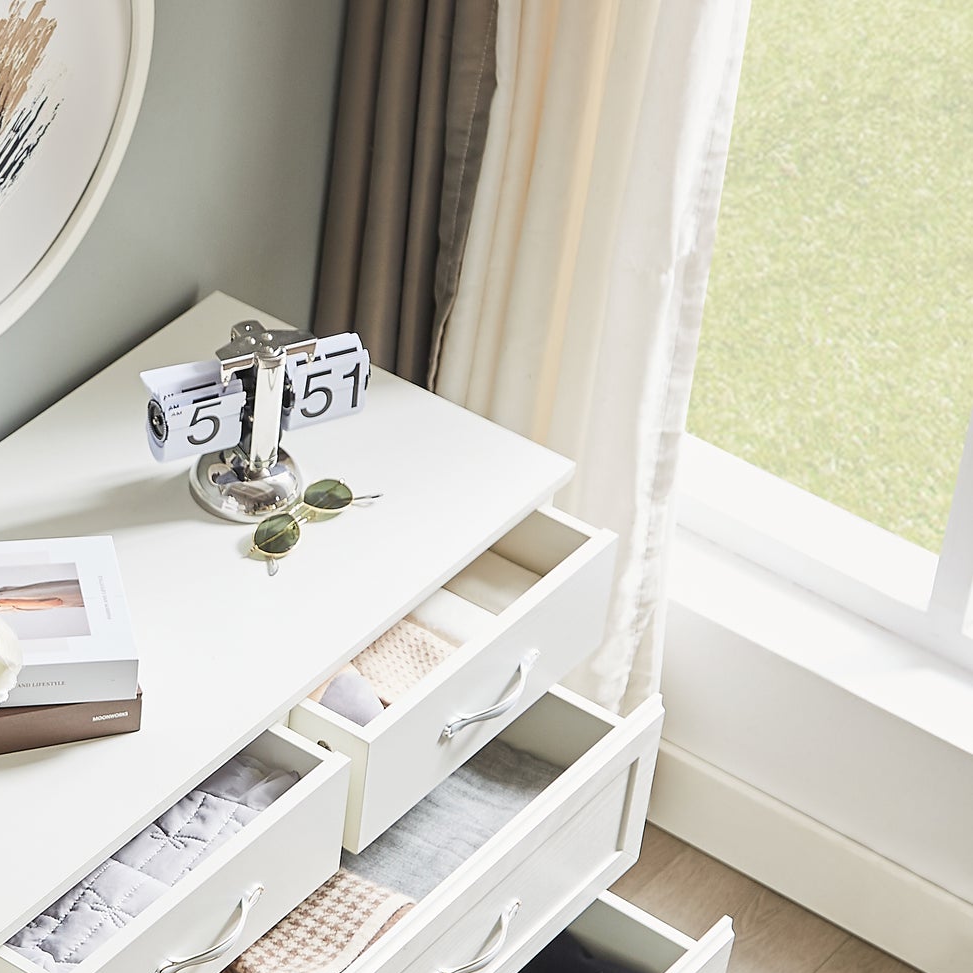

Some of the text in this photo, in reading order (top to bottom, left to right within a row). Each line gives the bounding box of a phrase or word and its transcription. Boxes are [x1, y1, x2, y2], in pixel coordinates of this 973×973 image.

[300, 362, 360, 418] 51
[187, 401, 221, 445] 5
[32, 680, 65, 688] LIFESTYLE
[92, 711, 129, 722] MOONWORKS
